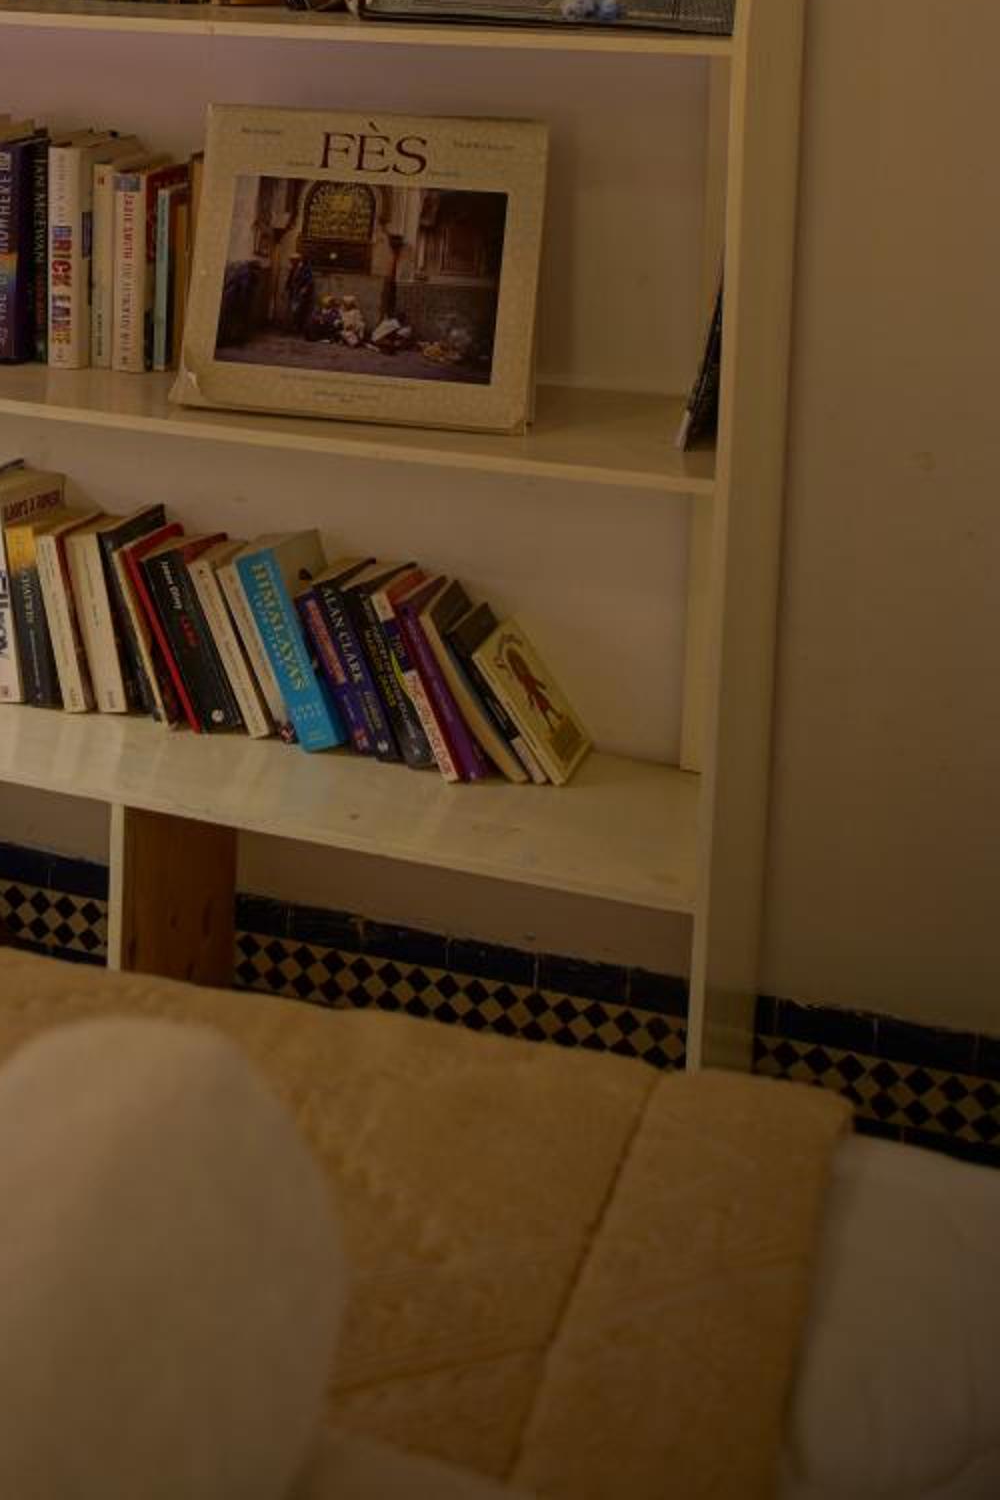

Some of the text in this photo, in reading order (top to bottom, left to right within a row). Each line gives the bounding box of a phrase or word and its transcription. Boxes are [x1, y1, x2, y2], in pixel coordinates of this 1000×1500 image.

[319, 121, 428, 177] FÈS
[51, 226, 72, 345] BRICK LANE
[121, 226, 135, 260] SMITH
[249, 561, 307, 693] HIMALAYAS
[319, 584, 347, 631] ALAN
[334, 628, 367, 684] CLARK
